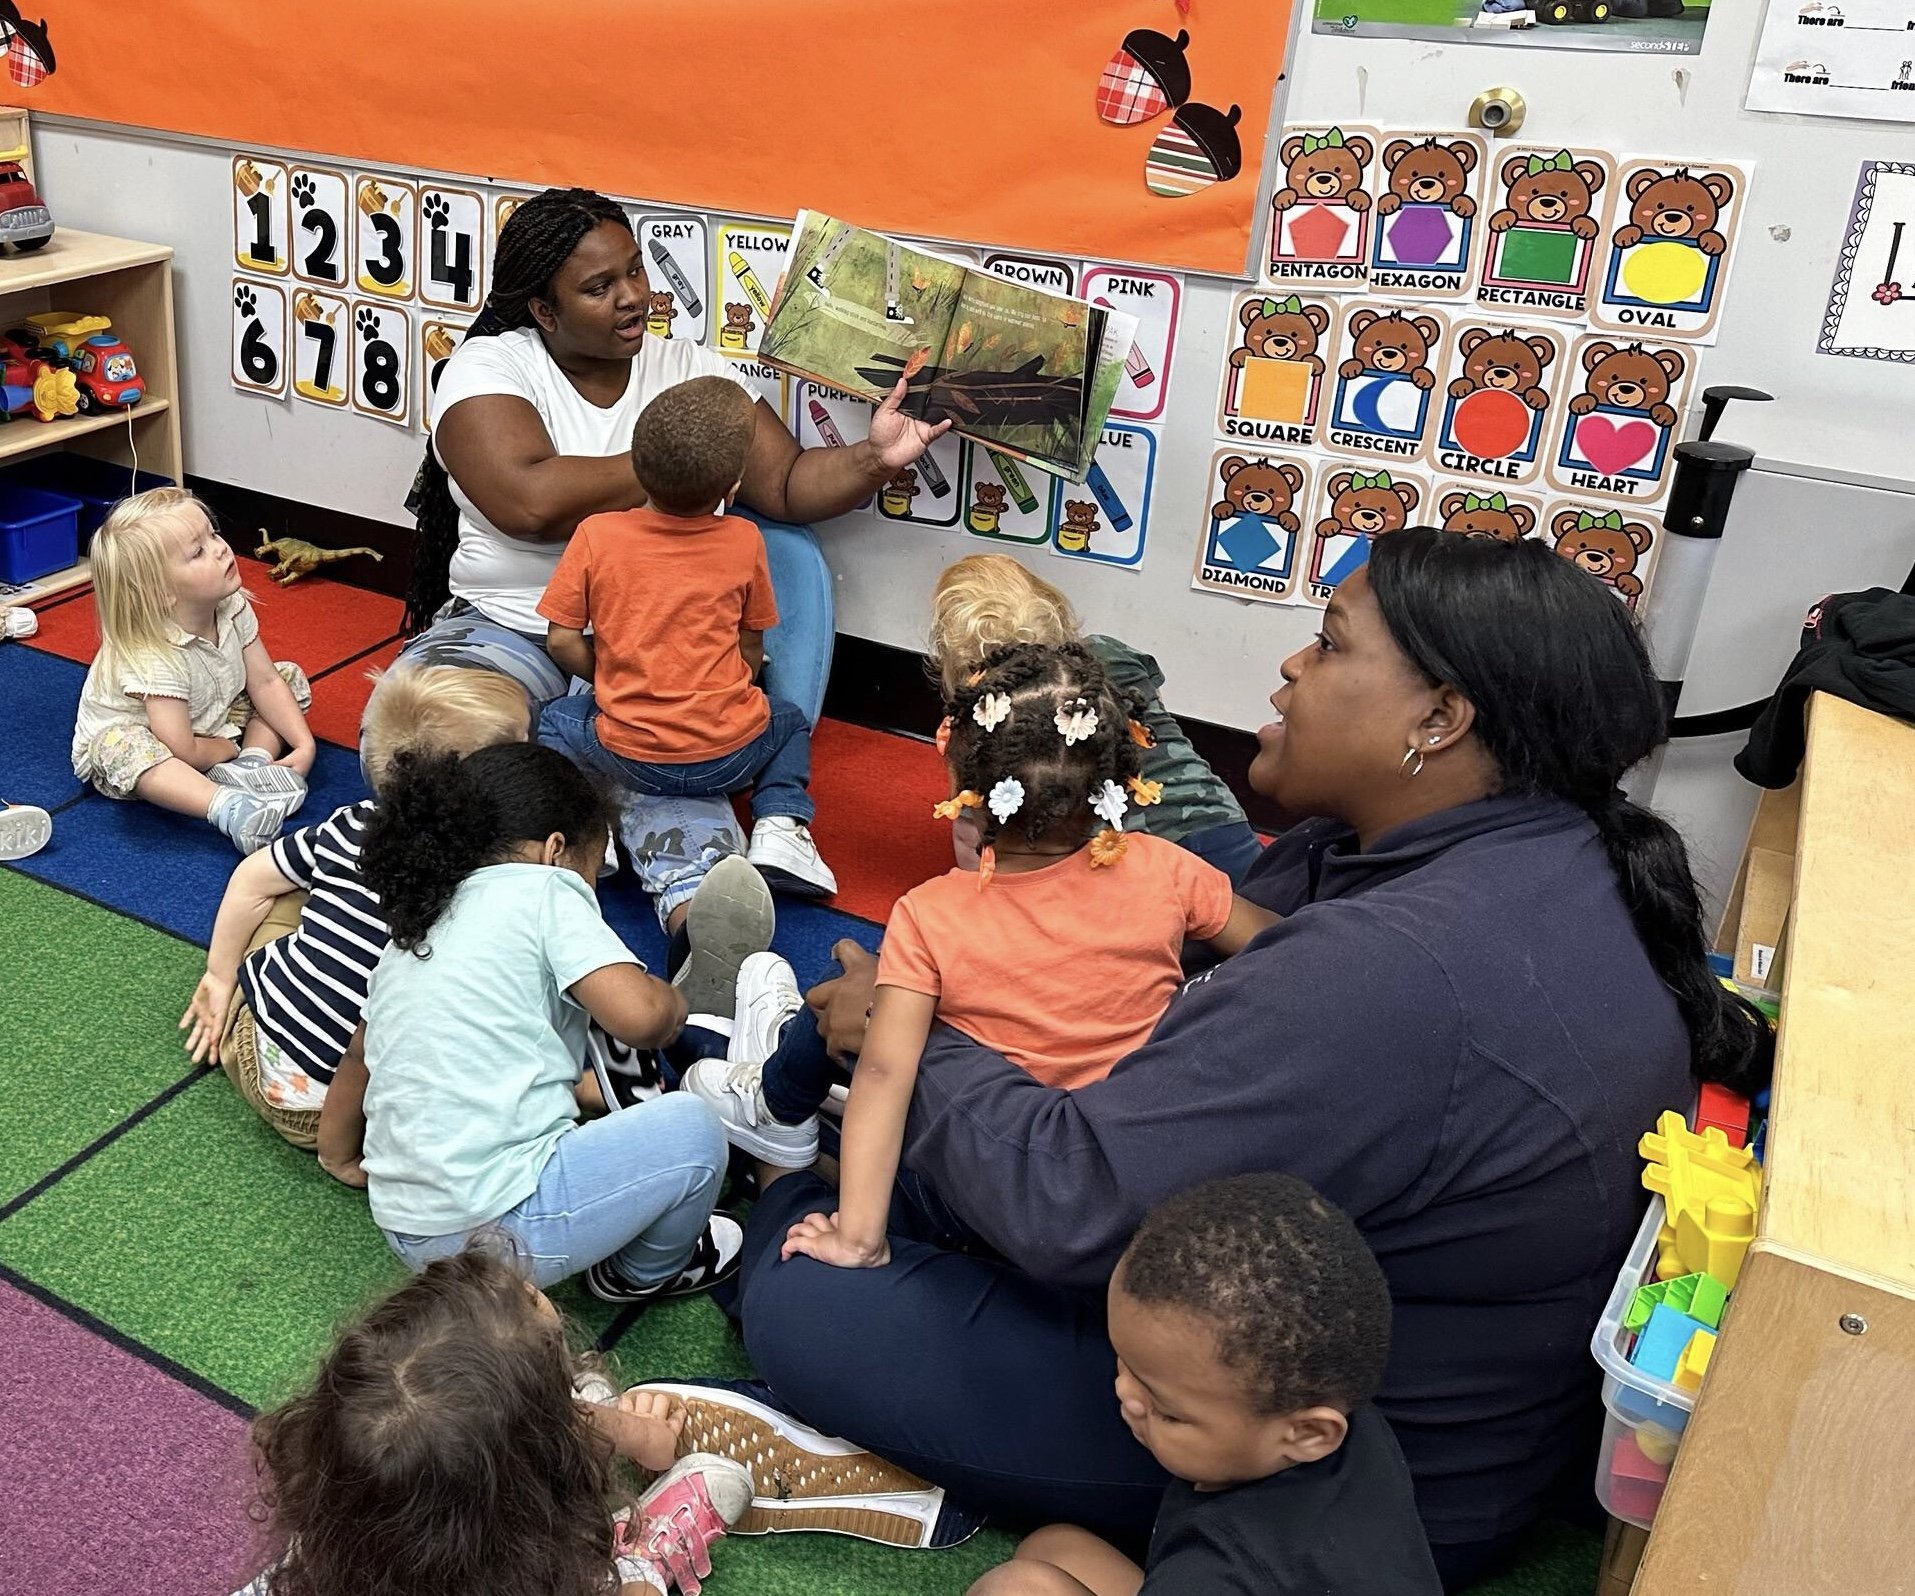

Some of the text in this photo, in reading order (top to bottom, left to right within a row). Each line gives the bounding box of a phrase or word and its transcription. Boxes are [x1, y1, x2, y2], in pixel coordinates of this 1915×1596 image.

[247, 192, 277, 264] 1
[652, 224, 694, 239] GRAY
[301, 209, 338, 281] 2
[365, 212, 404, 286] 3
[725, 233, 790, 252] YELLOW
[431, 229, 473, 303] 4
[994, 263, 1063, 286] BROWN
[1270, 263, 1368, 280] PENTAGON
[671, 273, 686, 290] gray
[1107, 277, 1155, 297] PINK
[1370, 272, 1461, 291] HEXAGON
[1477, 287, 1585, 311] RECTANGLE
[1618, 309, 1676, 328] OVAL
[241, 318, 278, 385] 6
[304, 320, 337, 393] 7
[362, 339, 400, 410] 8
[731, 362, 781, 380] ANGE
[1099, 431, 1133, 448] LUE
[1225, 419, 1312, 444] SQUARE
[1331, 432, 1419, 455] CRESCENT
[1004, 465, 1020, 488] green
[1440, 453, 1520, 479] CIRCLE
[1571, 472, 1638, 494] HEART
[1202, 568, 1286, 594] DIAMOND
